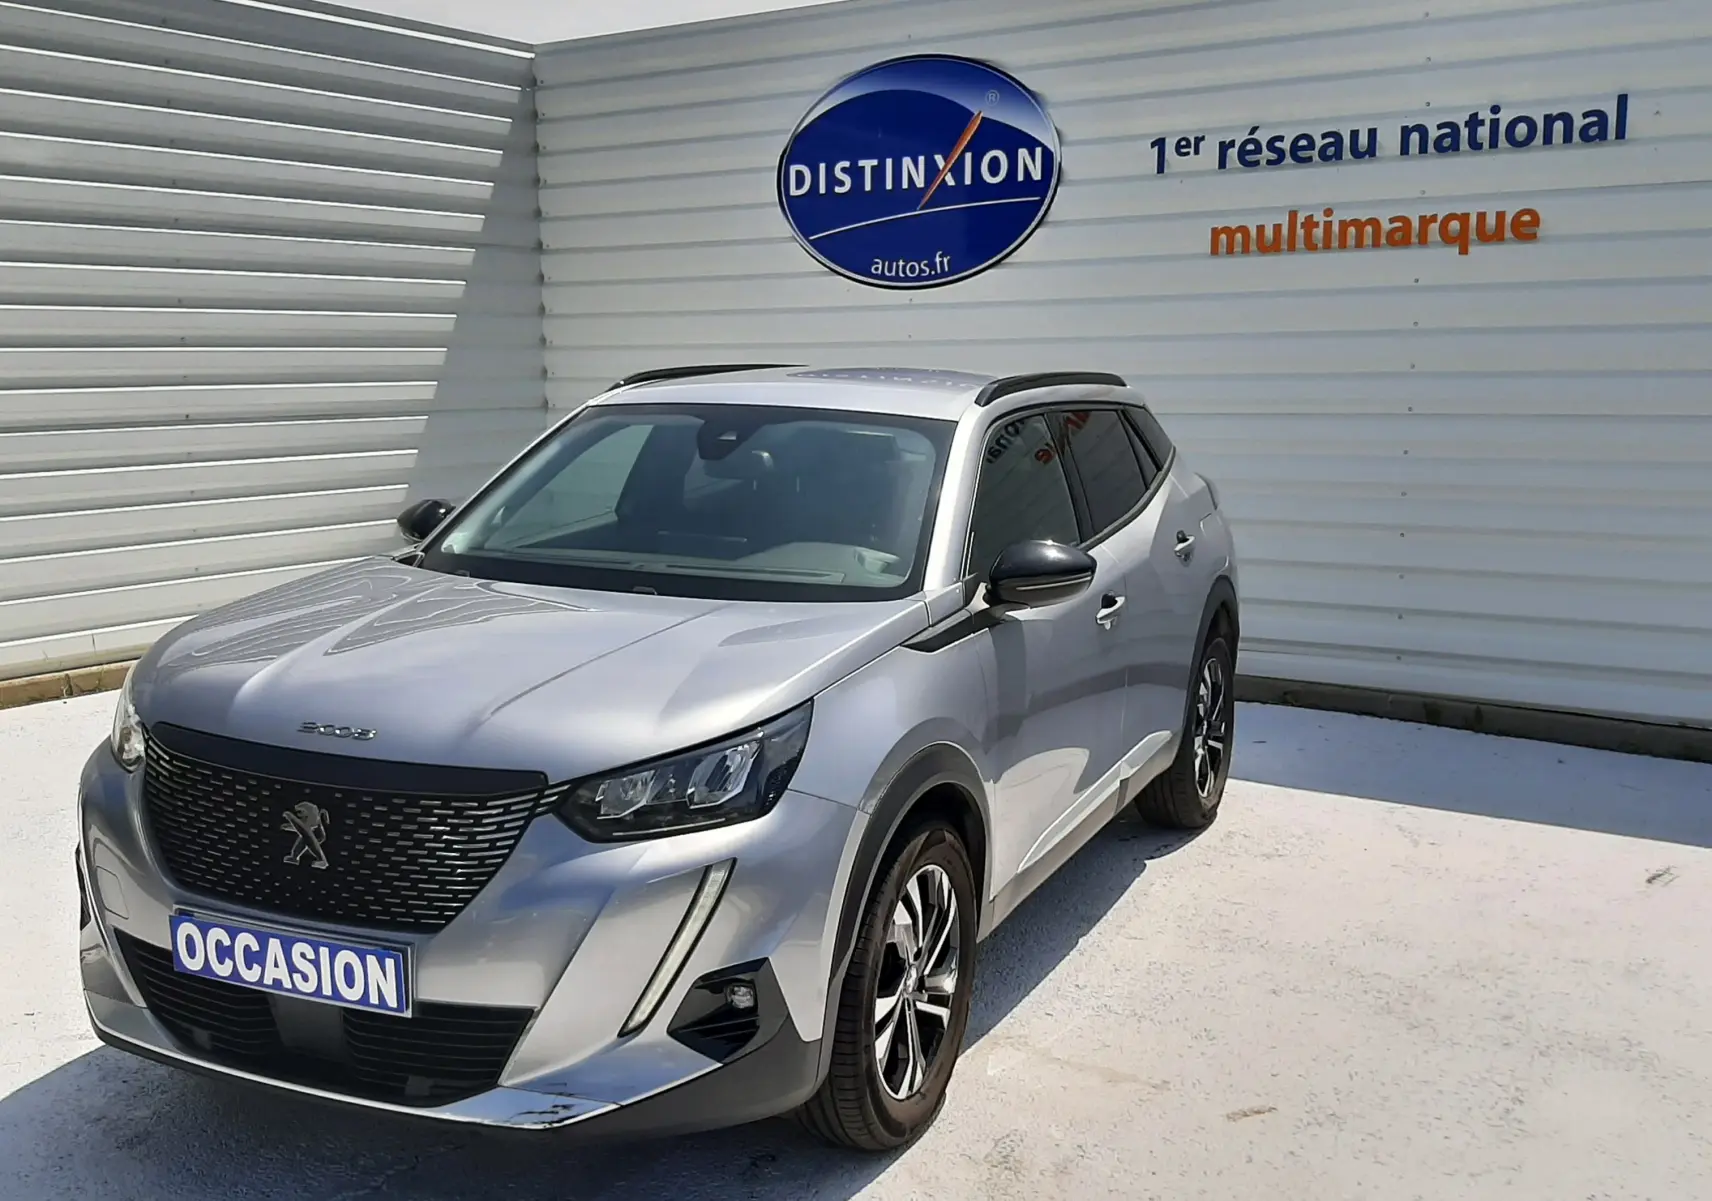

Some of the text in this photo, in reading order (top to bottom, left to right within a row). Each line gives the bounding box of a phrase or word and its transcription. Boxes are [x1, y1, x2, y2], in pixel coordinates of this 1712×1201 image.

[1217, 125, 1378, 170] réseau
[1400, 94, 1629, 156] national
[789, 147, 1043, 197] DISTINXION
[1209, 207, 1541, 256] multimarque
[870, 250, 951, 278] autos.fr
[175, 921, 399, 1009] OCCASION
